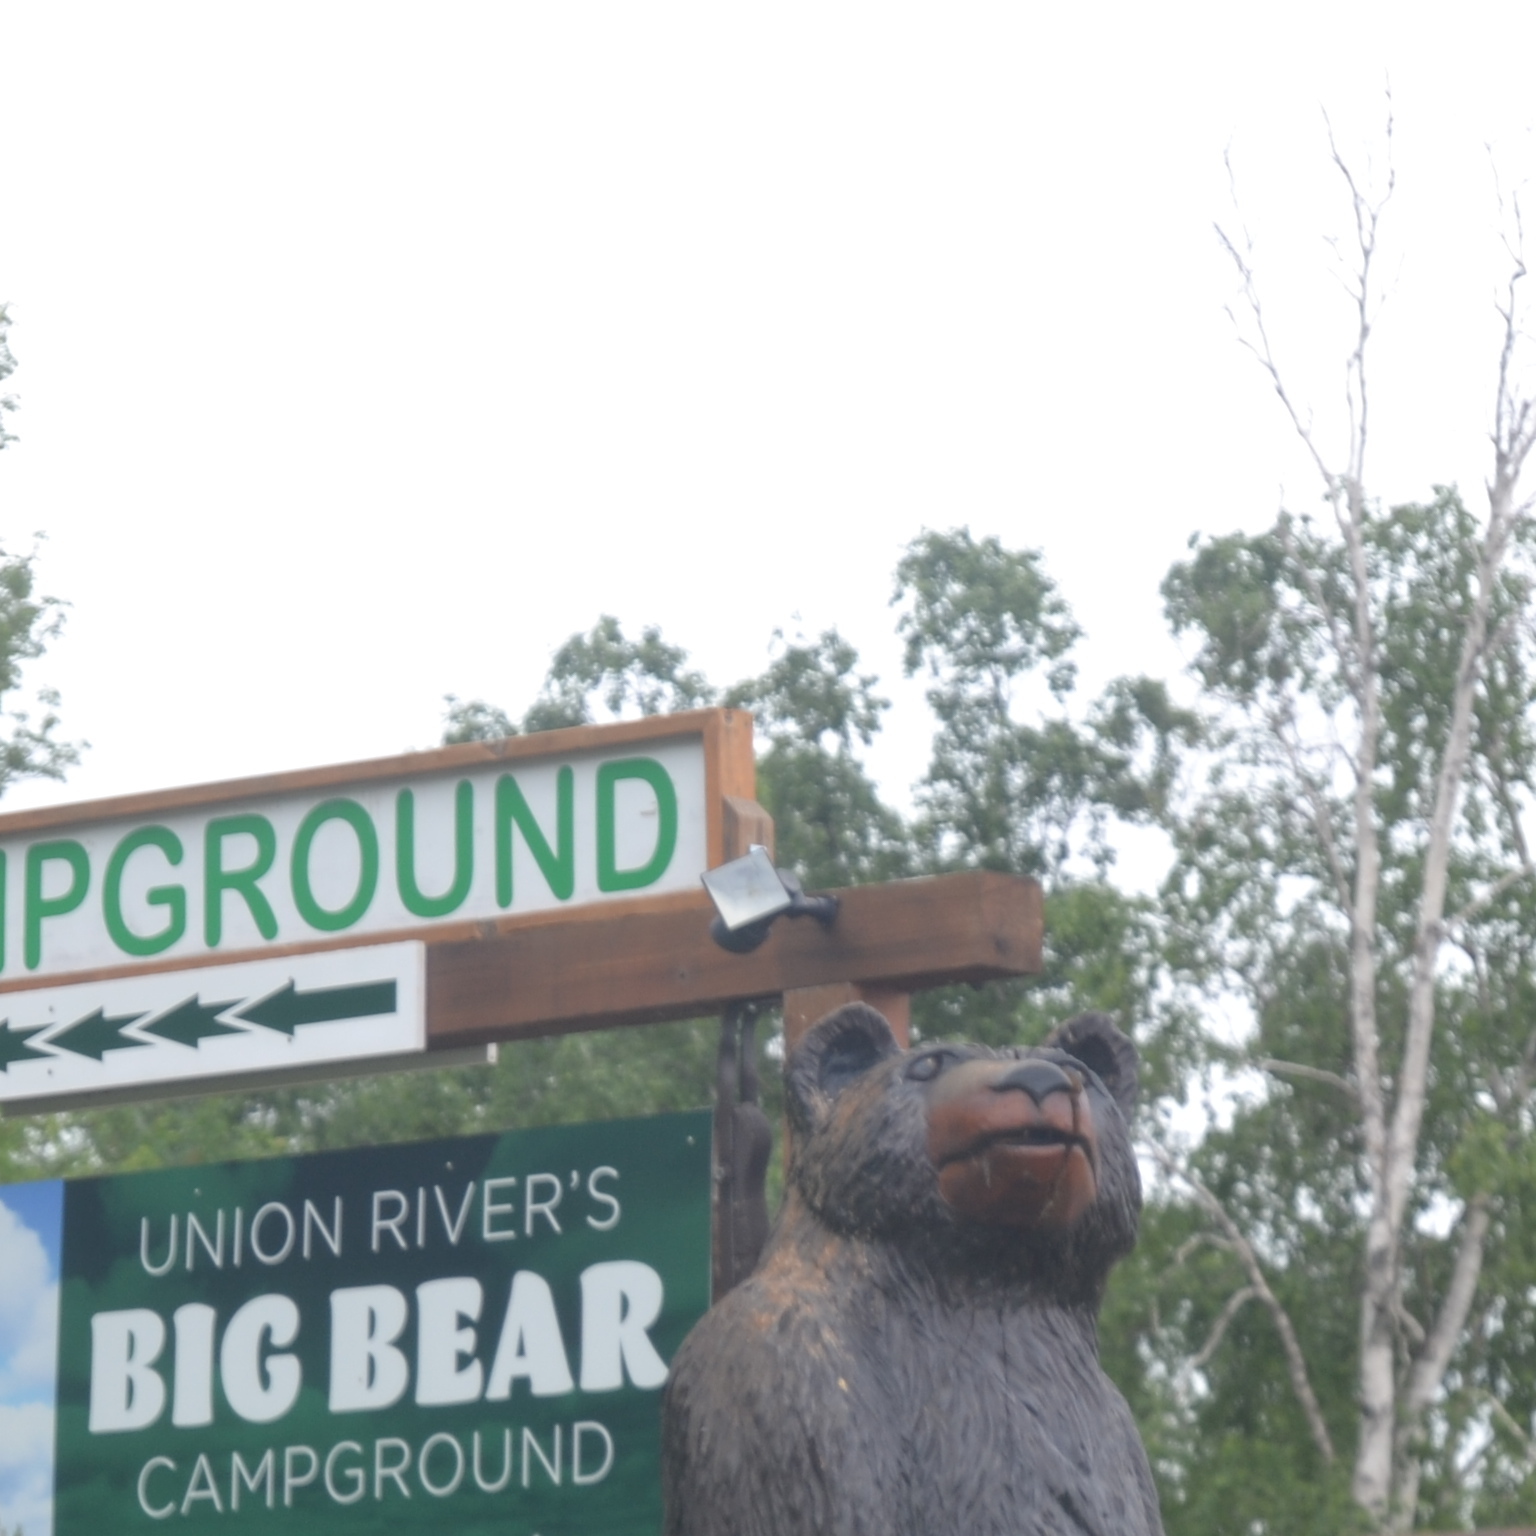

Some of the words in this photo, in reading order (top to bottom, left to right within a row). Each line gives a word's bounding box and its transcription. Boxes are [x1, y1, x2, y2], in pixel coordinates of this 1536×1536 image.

[138, 1198, 344, 1275] UNION
[368, 1165, 622, 1252] RIVER'S
[88, 1293, 302, 1433] BIG
[328, 1259, 668, 1414] BEAR
[137, 1420, 614, 1520] CAMPGROUND
